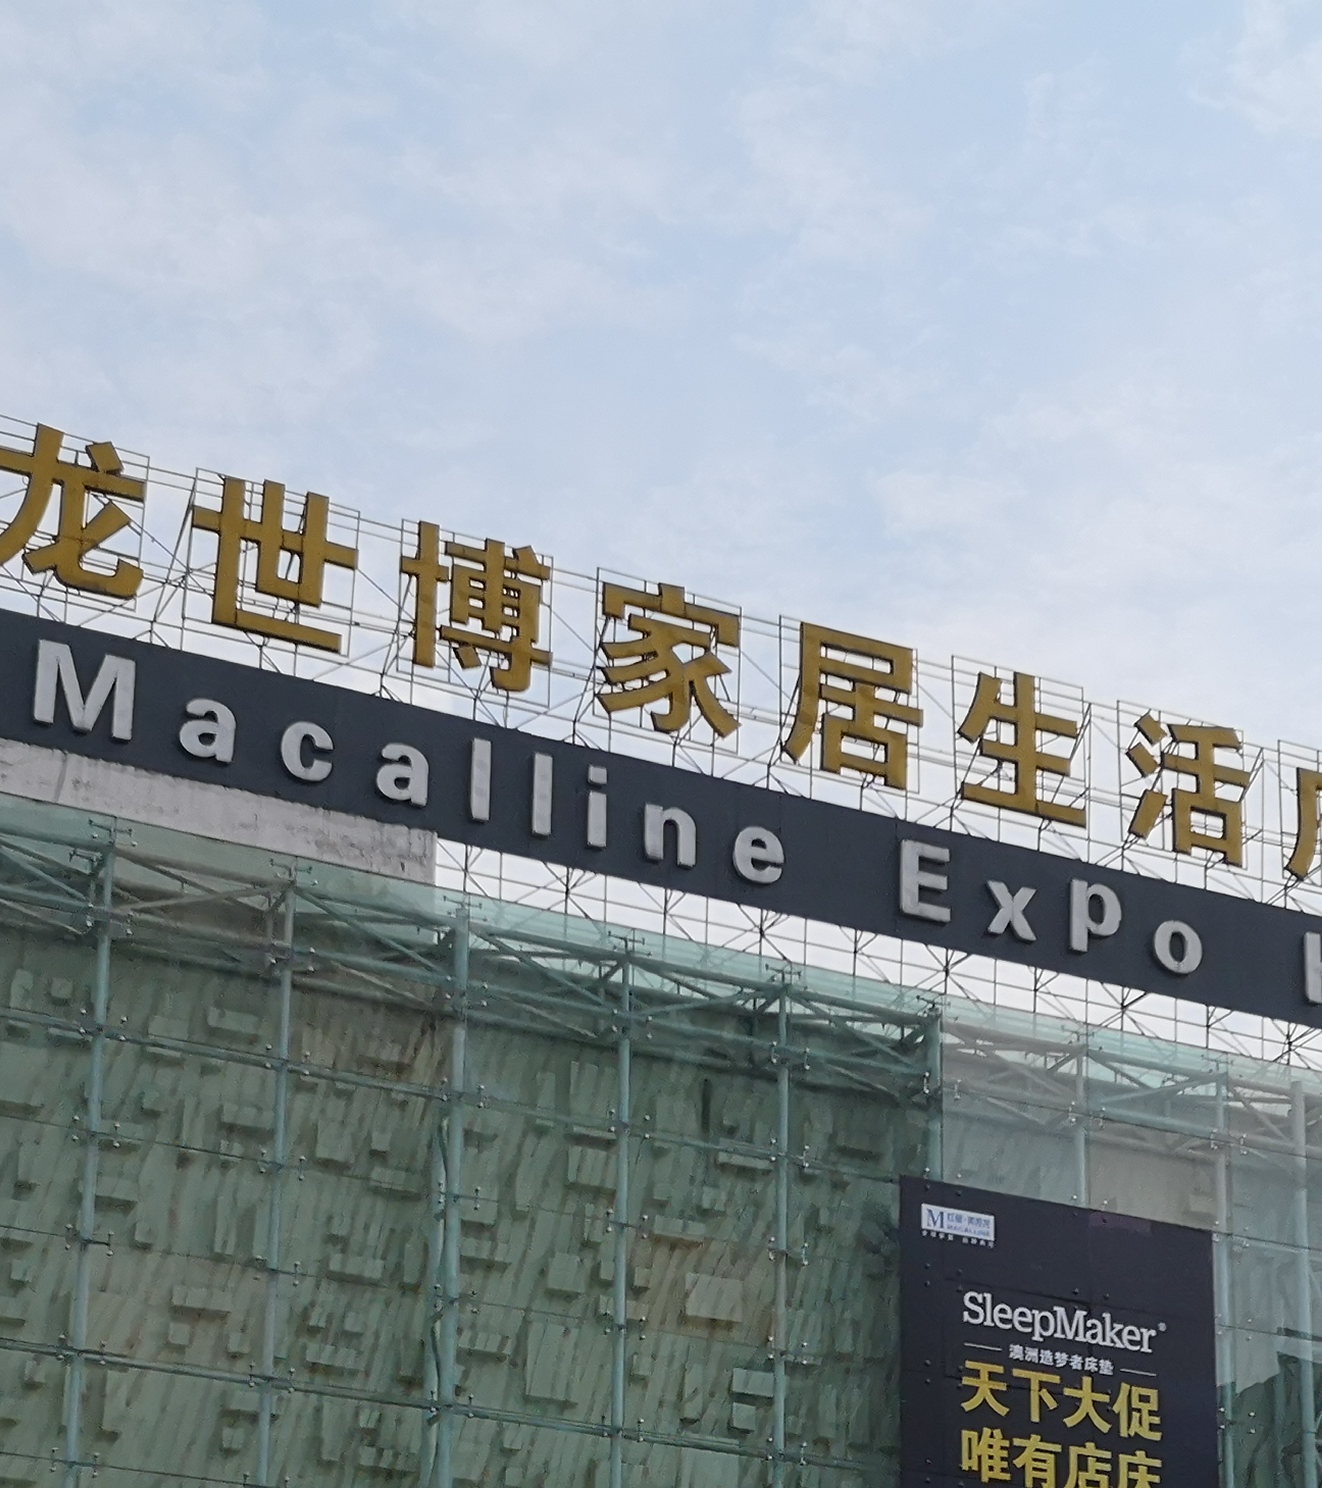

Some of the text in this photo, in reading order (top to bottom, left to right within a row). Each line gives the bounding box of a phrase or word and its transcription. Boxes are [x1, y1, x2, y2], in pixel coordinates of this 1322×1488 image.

[32, 639, 785, 885] Macalline
[899, 839, 1203, 975] Expo
[963, 1291, 1157, 1353] SleepMaker
[1008, 1344, 1114, 1376] 澳洲造梦者床垫
[961, 1360, 1163, 1441] 天下大促
